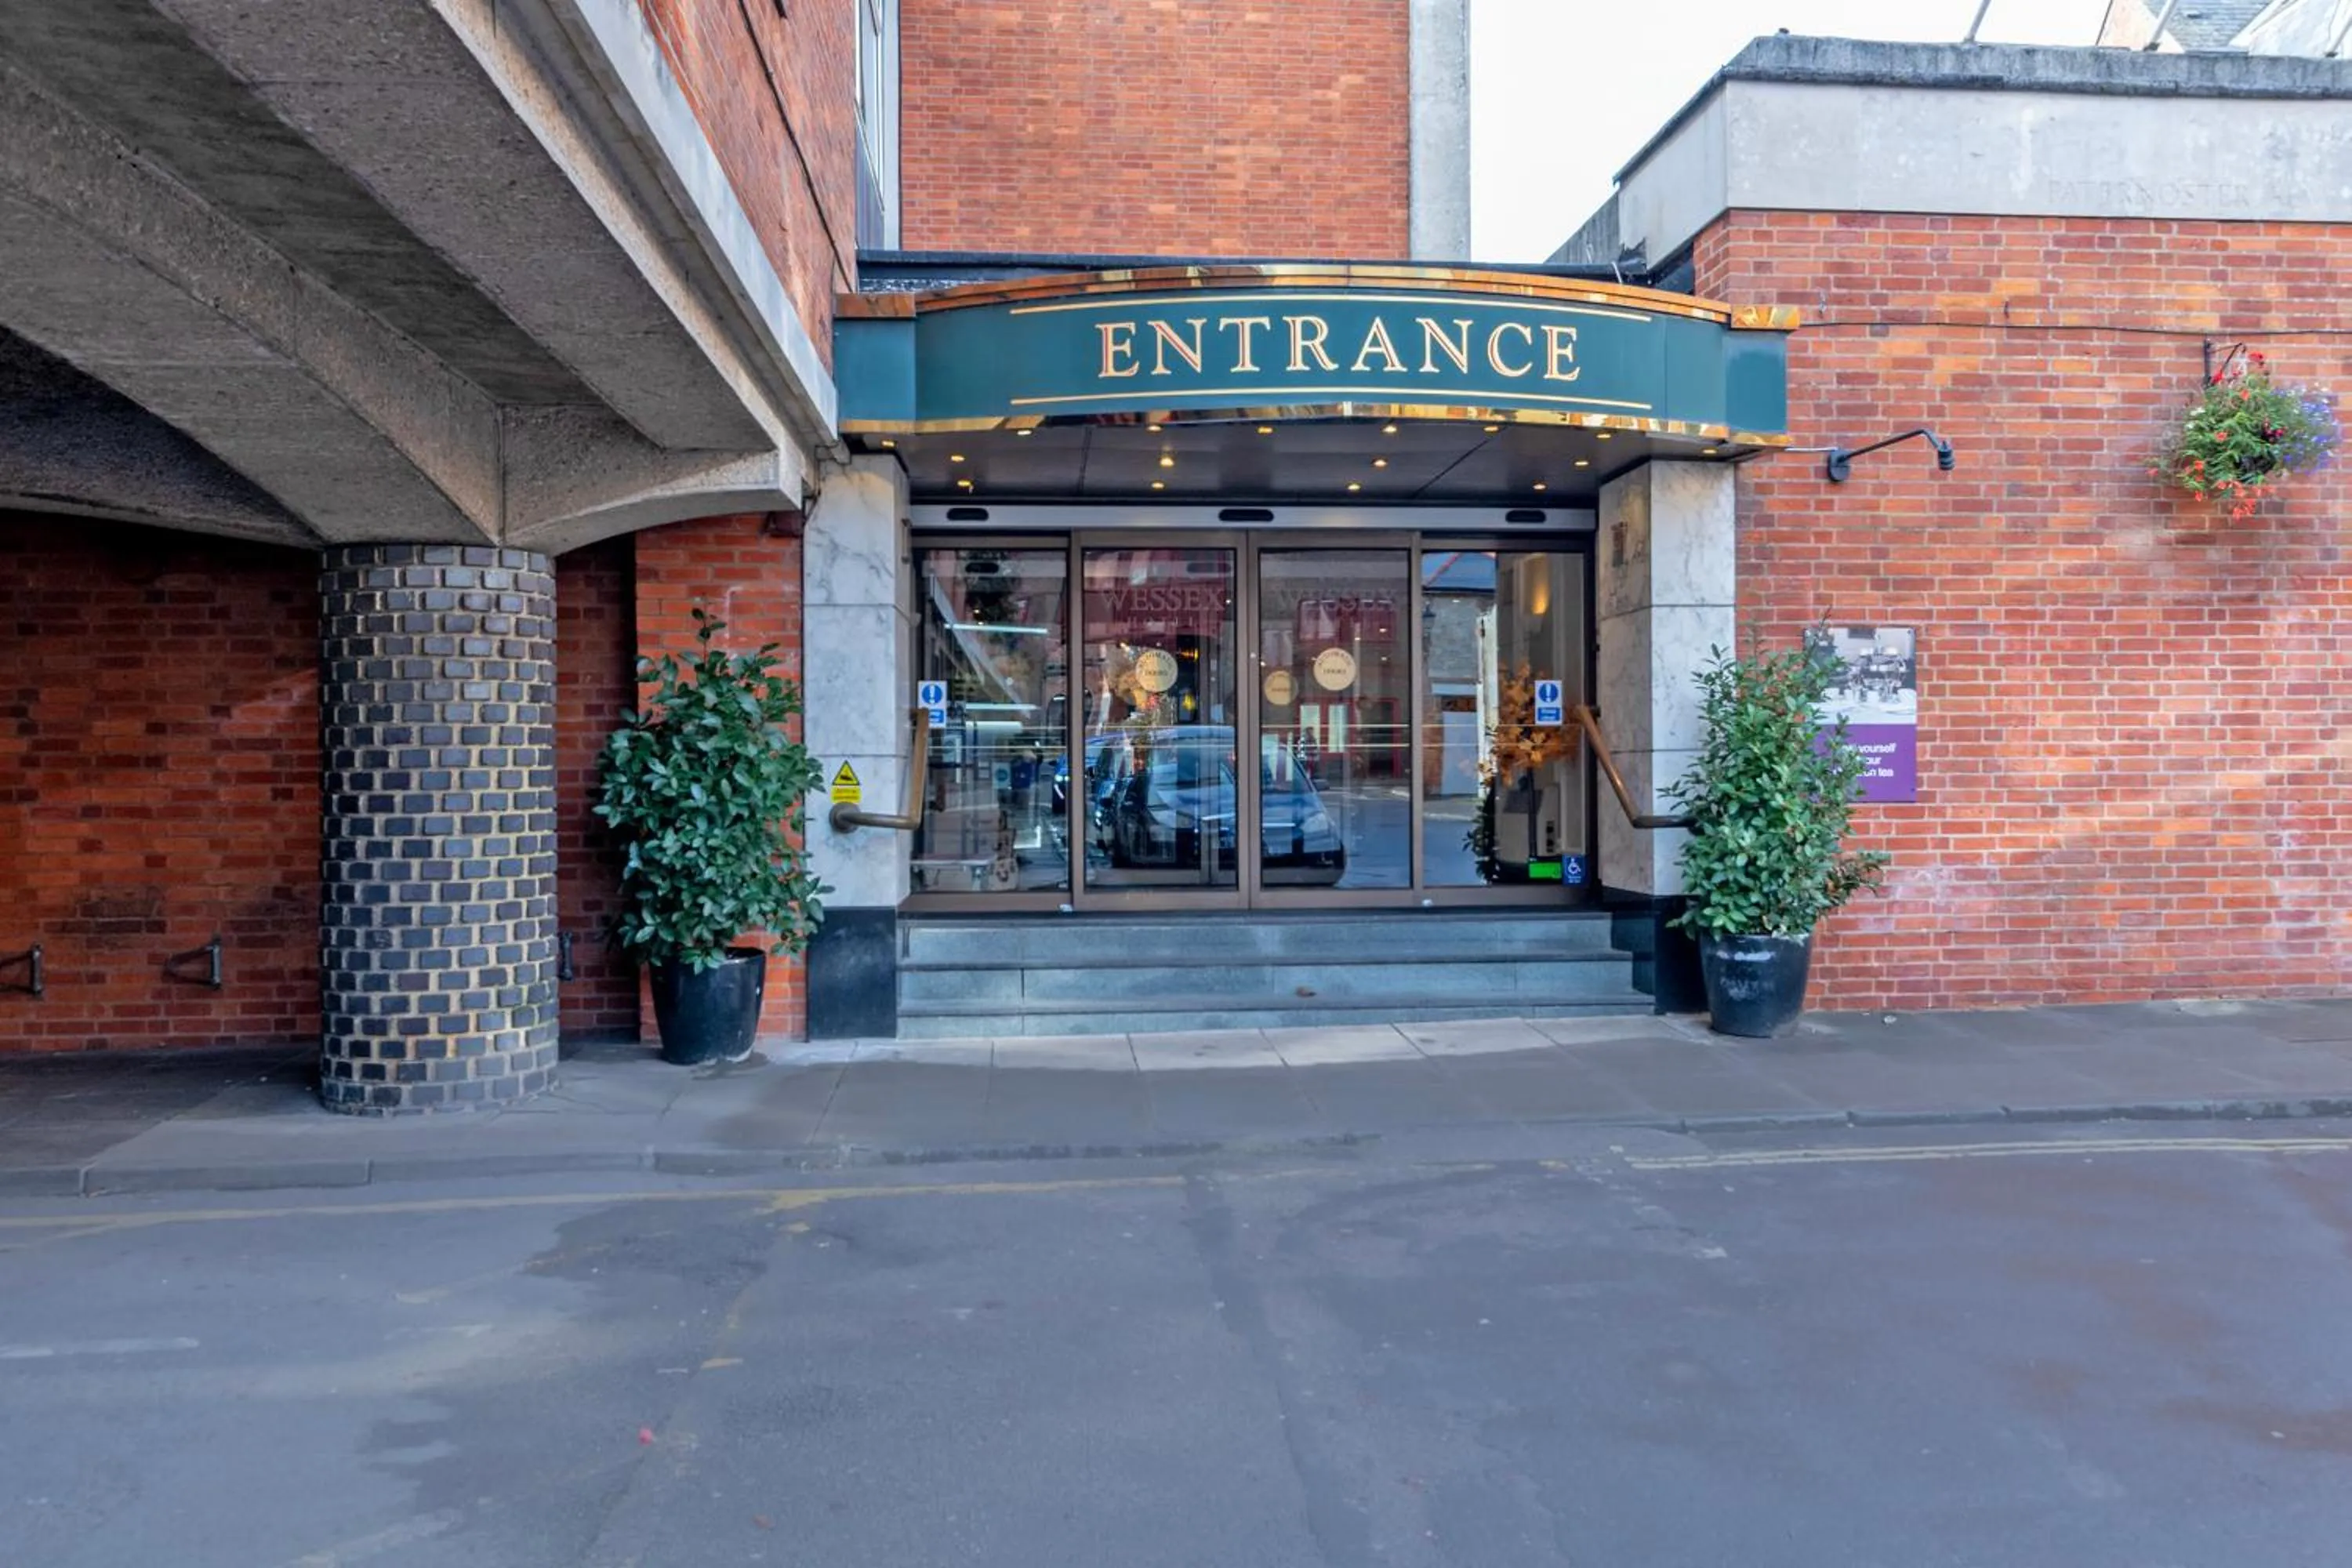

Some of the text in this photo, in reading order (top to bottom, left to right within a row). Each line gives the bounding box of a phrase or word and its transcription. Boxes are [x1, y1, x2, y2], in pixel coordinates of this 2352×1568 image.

[1094, 315, 1580, 381] ENTRANCE
[1102, 588, 1226, 611] WESSEX
[1857, 743, 1896, 754] yourself
[1878, 768, 1894, 777] tea
